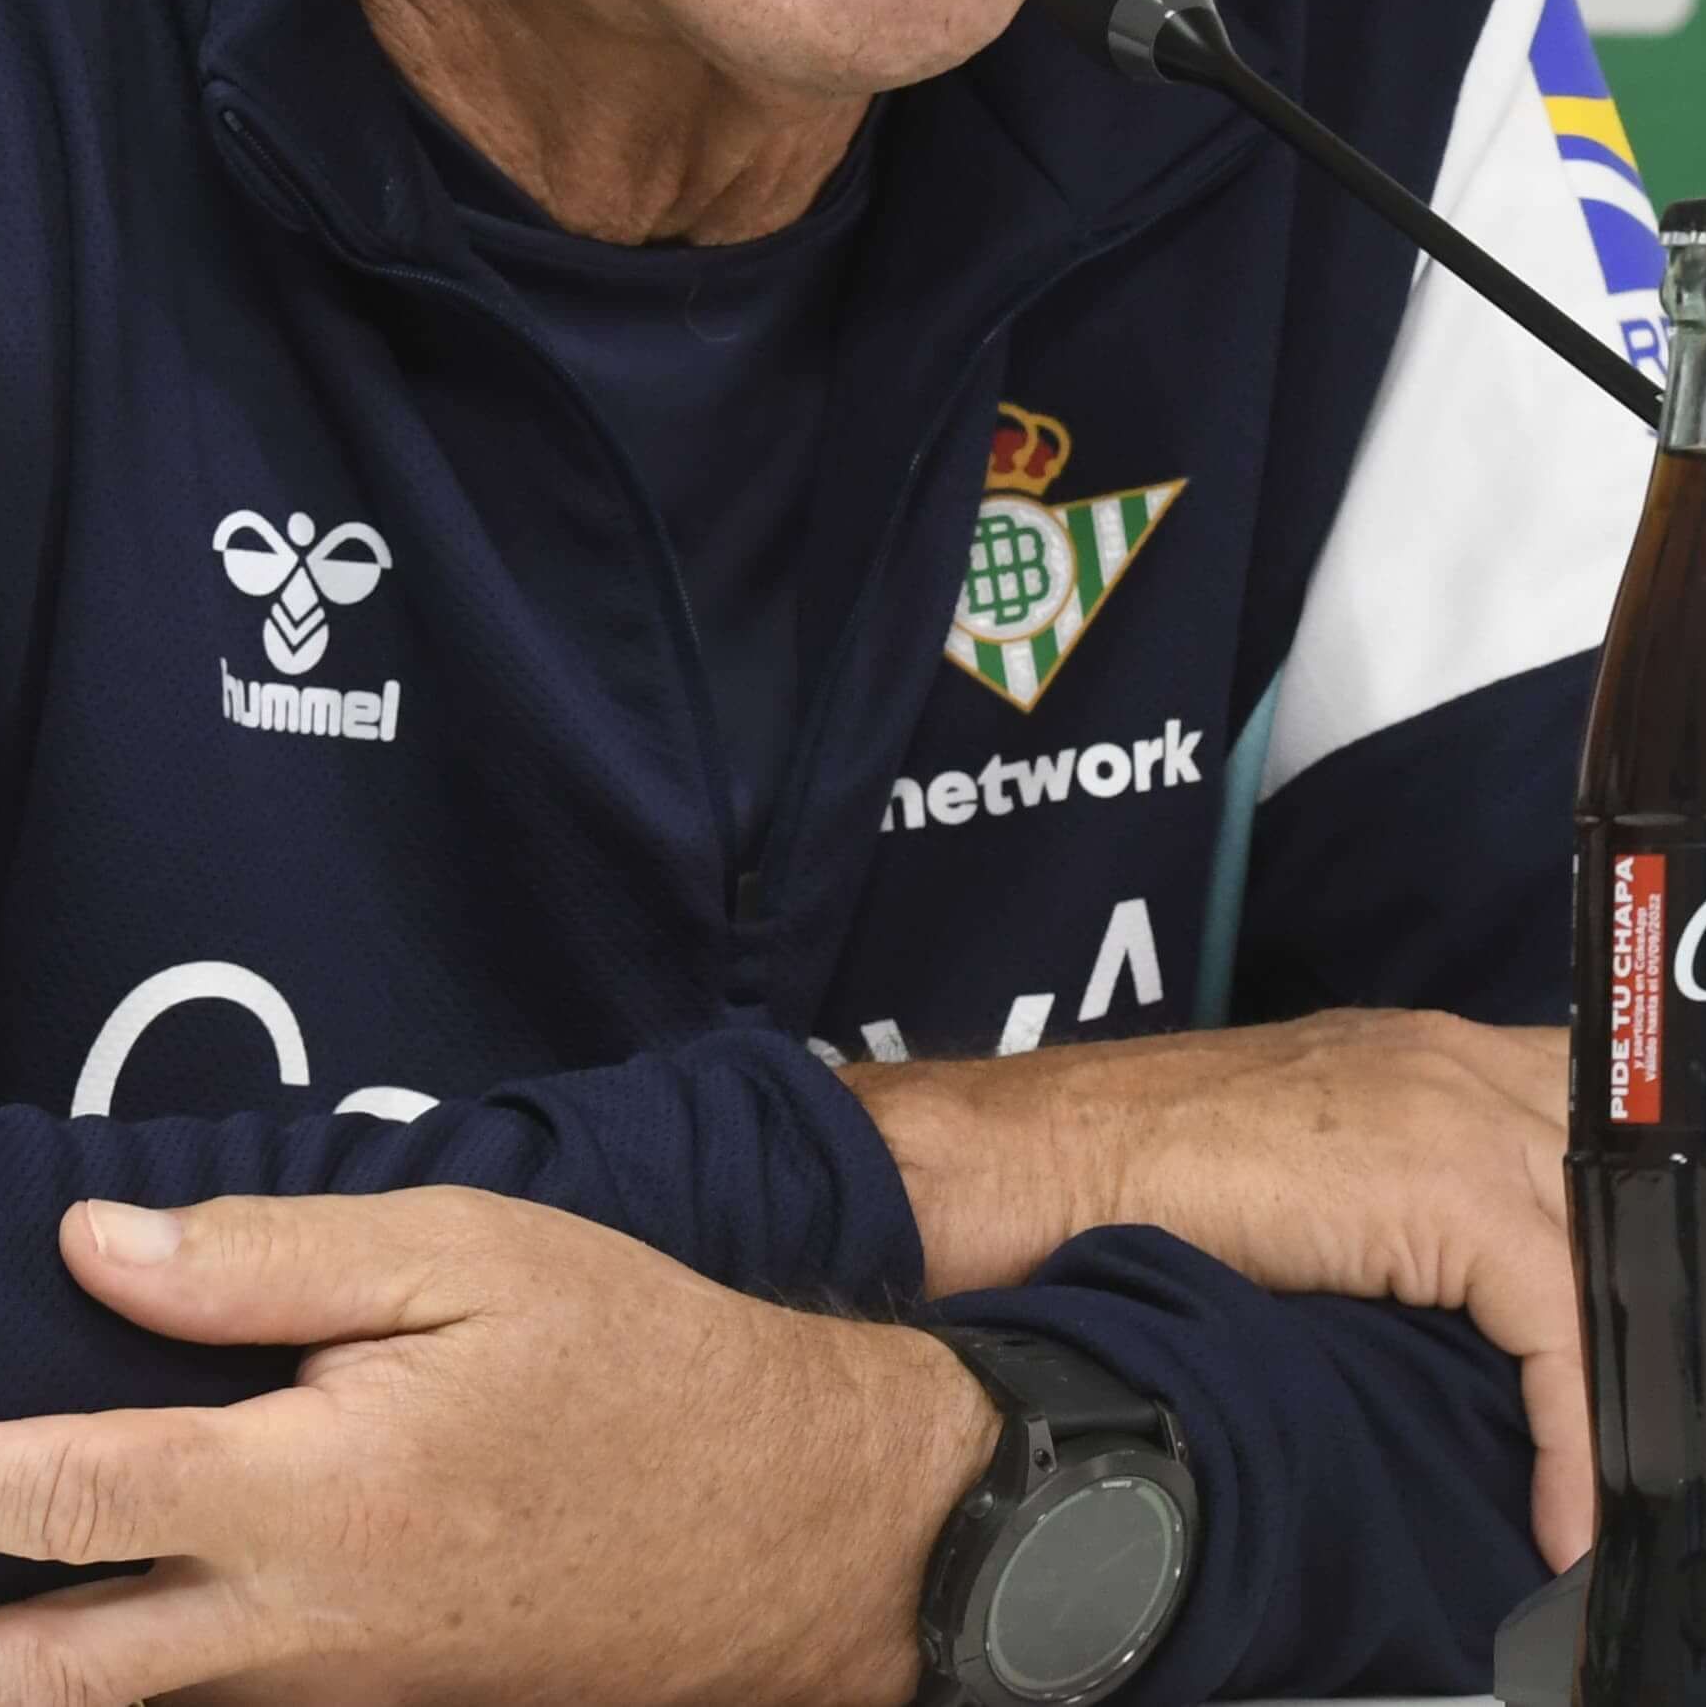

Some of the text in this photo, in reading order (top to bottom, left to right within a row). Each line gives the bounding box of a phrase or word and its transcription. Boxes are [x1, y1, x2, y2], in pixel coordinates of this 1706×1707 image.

[221, 658, 400, 742] hummel
[882, 719, 1202, 830] network
[1611, 856, 1634, 1119] PIDE TU CHAPA
